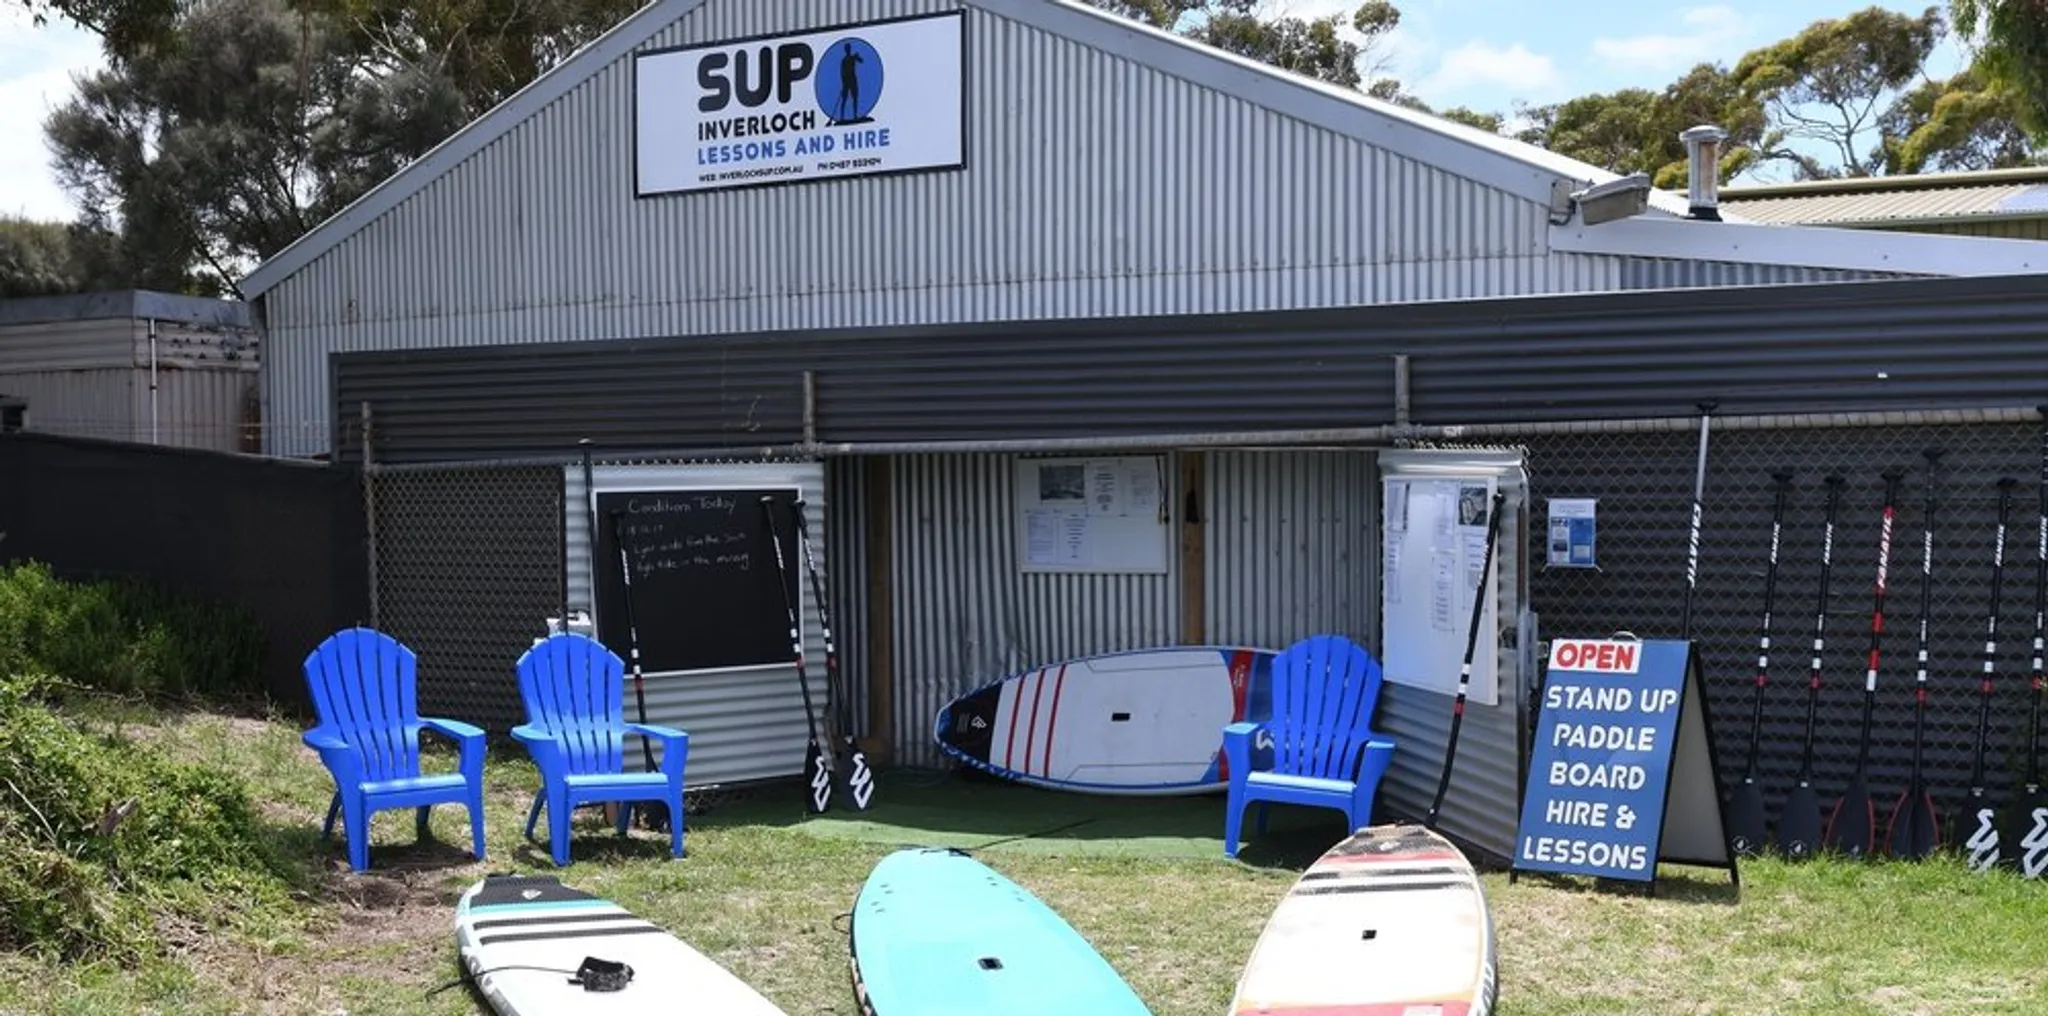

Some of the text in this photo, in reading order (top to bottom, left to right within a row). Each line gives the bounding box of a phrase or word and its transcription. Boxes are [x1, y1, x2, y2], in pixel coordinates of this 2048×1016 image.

[697, 42, 814, 113] SUP
[698, 110, 815, 141] INVERLOCH
[698, 128, 891, 166] LESSONS AND HIRE
[690, 495, 737, 516] Today
[1877, 515, 1893, 589] FANATIC
[1556, 643, 1635, 670] OPEN
[1546, 685, 1677, 713] STAND UP
[1553, 724, 1656, 751] PADDLE
[1549, 761, 1646, 790] BOARD
[1546, 799, 1637, 829] HIRE &
[1523, 836, 1647, 871] LESSONS
